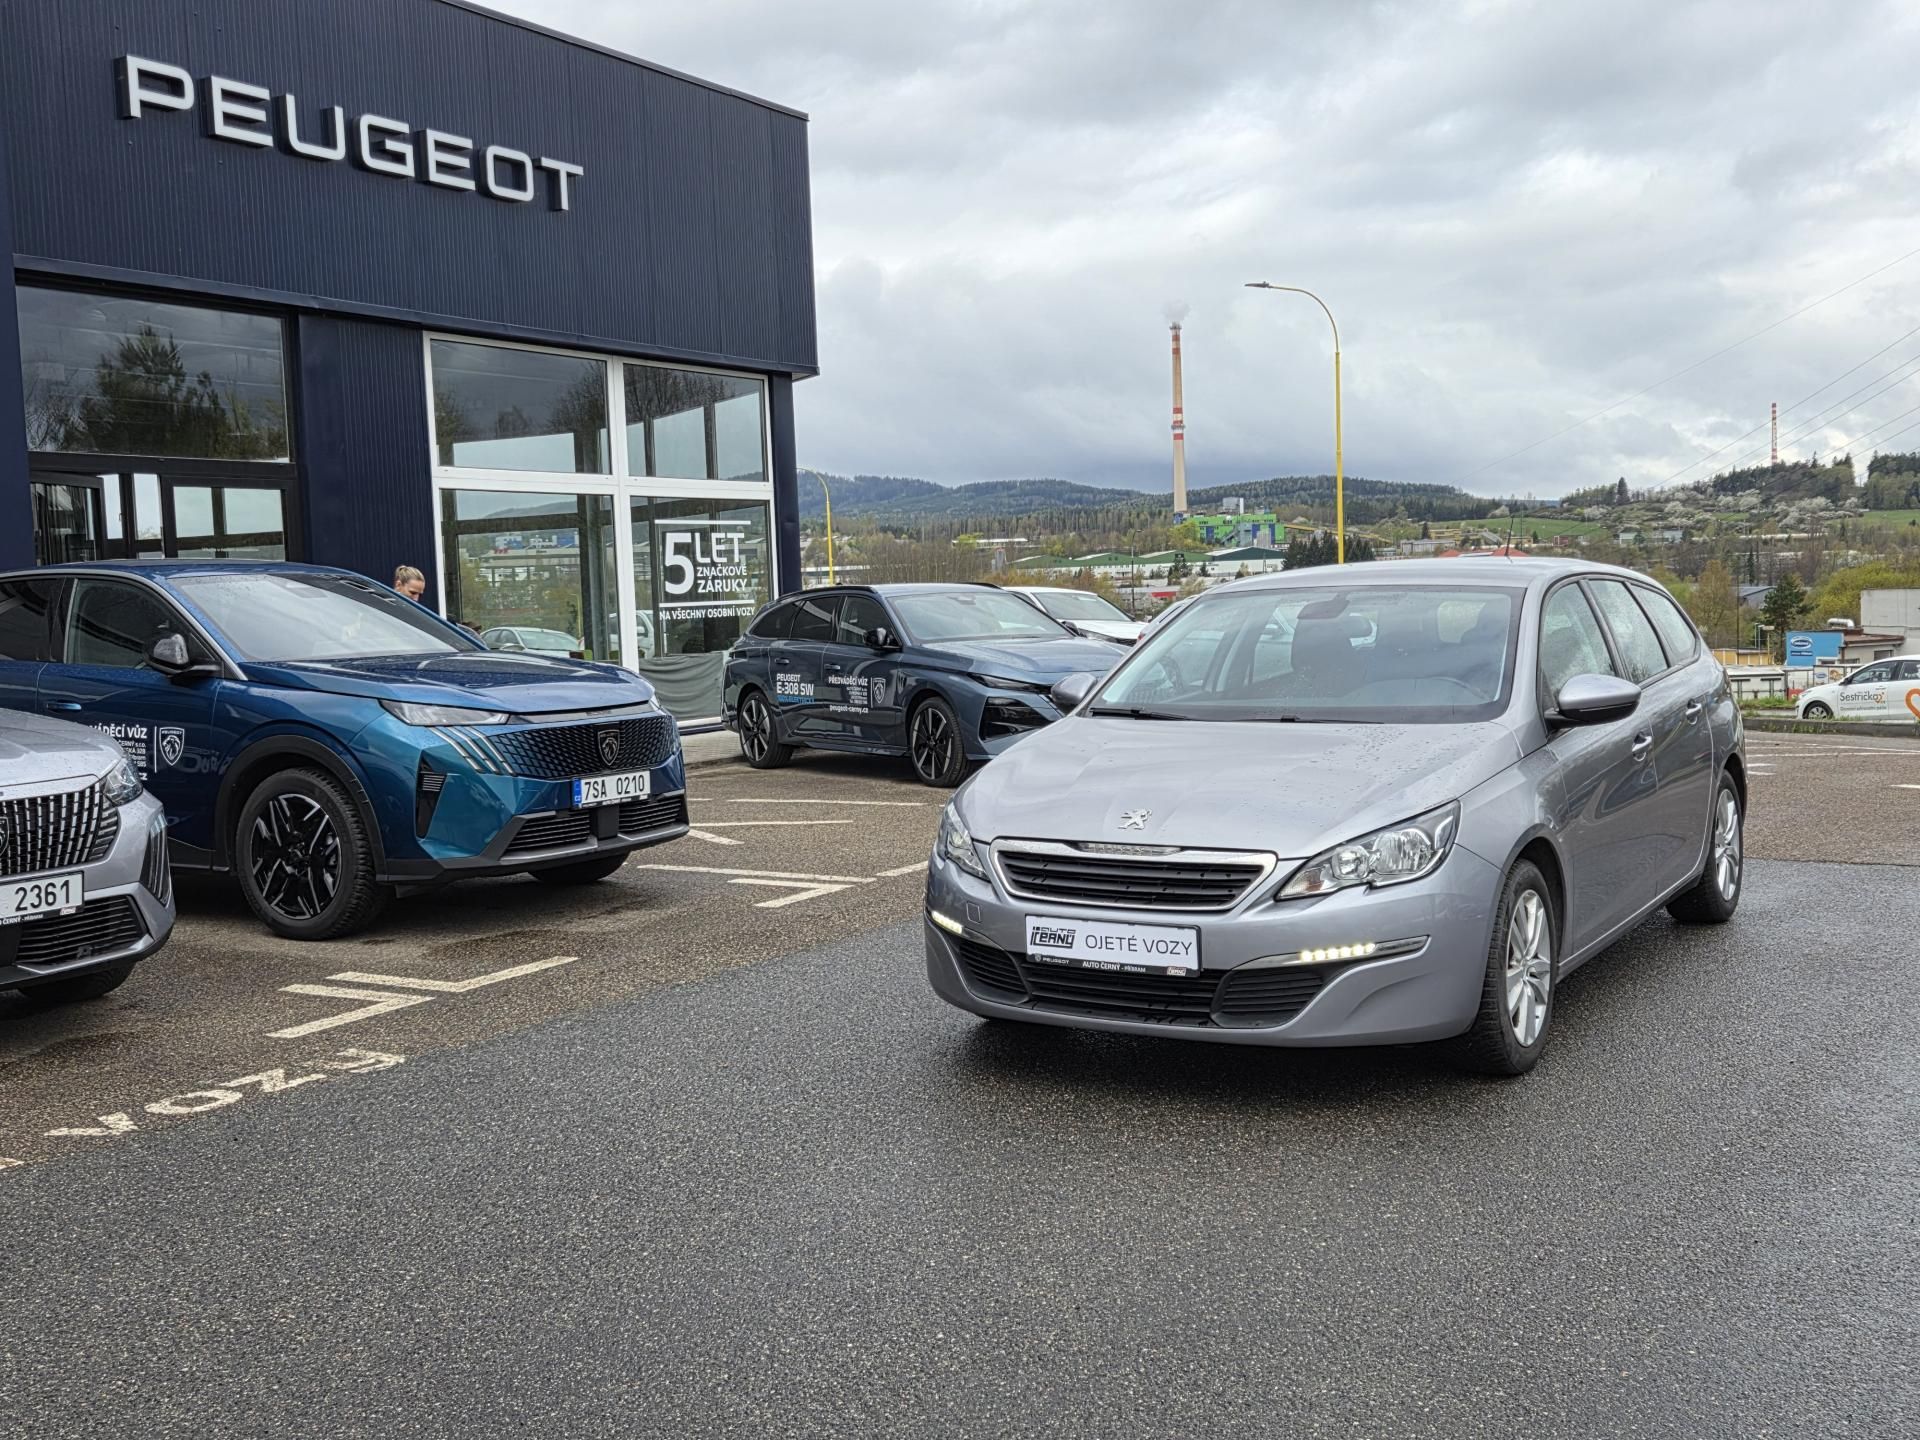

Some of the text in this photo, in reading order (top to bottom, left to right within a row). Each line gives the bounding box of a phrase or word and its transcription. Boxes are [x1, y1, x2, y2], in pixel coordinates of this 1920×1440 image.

[121, 54, 585, 212] PEUGEOT
[664, 532, 745, 594] 5 LET
[697, 564, 747, 577] ZNAČKOVÉ
[697, 576, 747, 593] ZÁRUKY
[659, 606, 755, 621] NA VŠECHNY OSOBNÍ VOZY
[776, 673, 801, 682] PEUGEOT
[776, 682, 814, 696] E-308 SW
[127, 724, 147, 739] VŮZ
[584, 774, 645, 801] 7SA 0210
[15, 879, 70, 911] 2361
[1085, 934, 1192, 956] OJETÉ VOZY
[1042, 957, 1069, 965] PEUGEOT
[1082, 960, 1100, 969] AUTO
[1100, 961, 1121, 971] ČERNÝ
